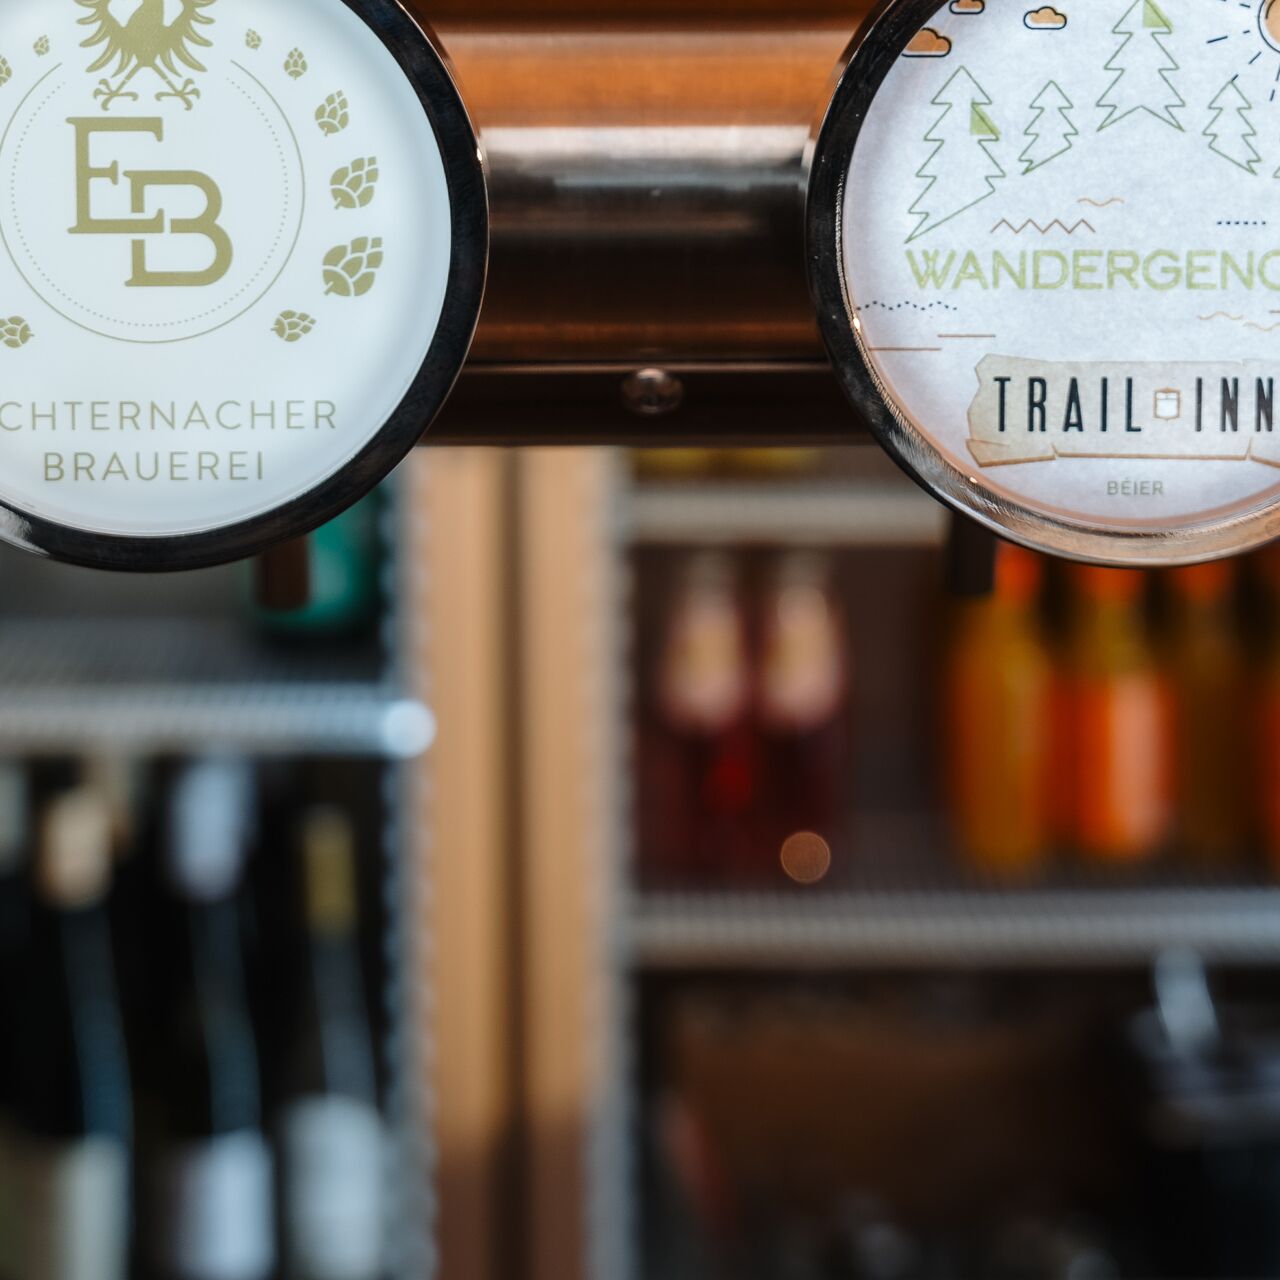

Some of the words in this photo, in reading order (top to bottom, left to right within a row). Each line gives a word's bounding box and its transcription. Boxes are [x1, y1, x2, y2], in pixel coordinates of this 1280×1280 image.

[65, 116, 233, 287] EB
[993, 376, 1143, 433] TRAIL
[1195, 376, 1275, 433] INN
[43, 450, 263, 482] BRAUEREI
